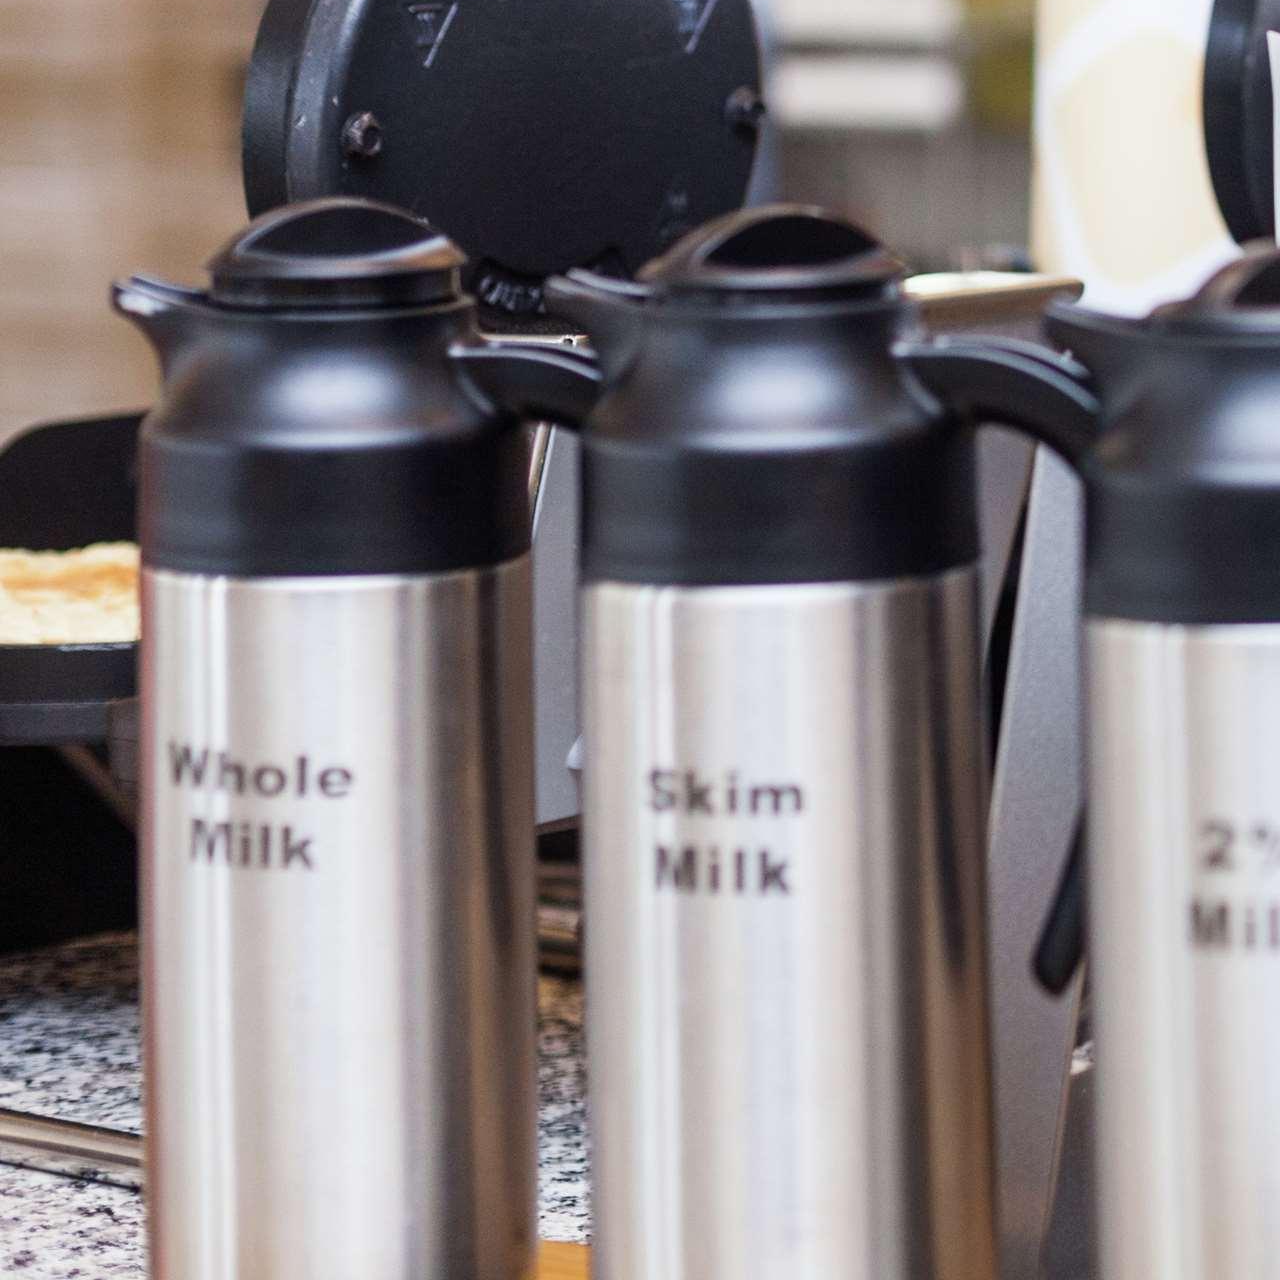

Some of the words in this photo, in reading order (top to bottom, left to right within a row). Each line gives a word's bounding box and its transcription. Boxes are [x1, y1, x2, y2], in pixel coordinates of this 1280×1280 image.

[168, 739, 355, 798] Whole
[648, 767, 805, 816] Skim
[191, 817, 314, 871] Milk
[654, 845, 791, 895] Milk
